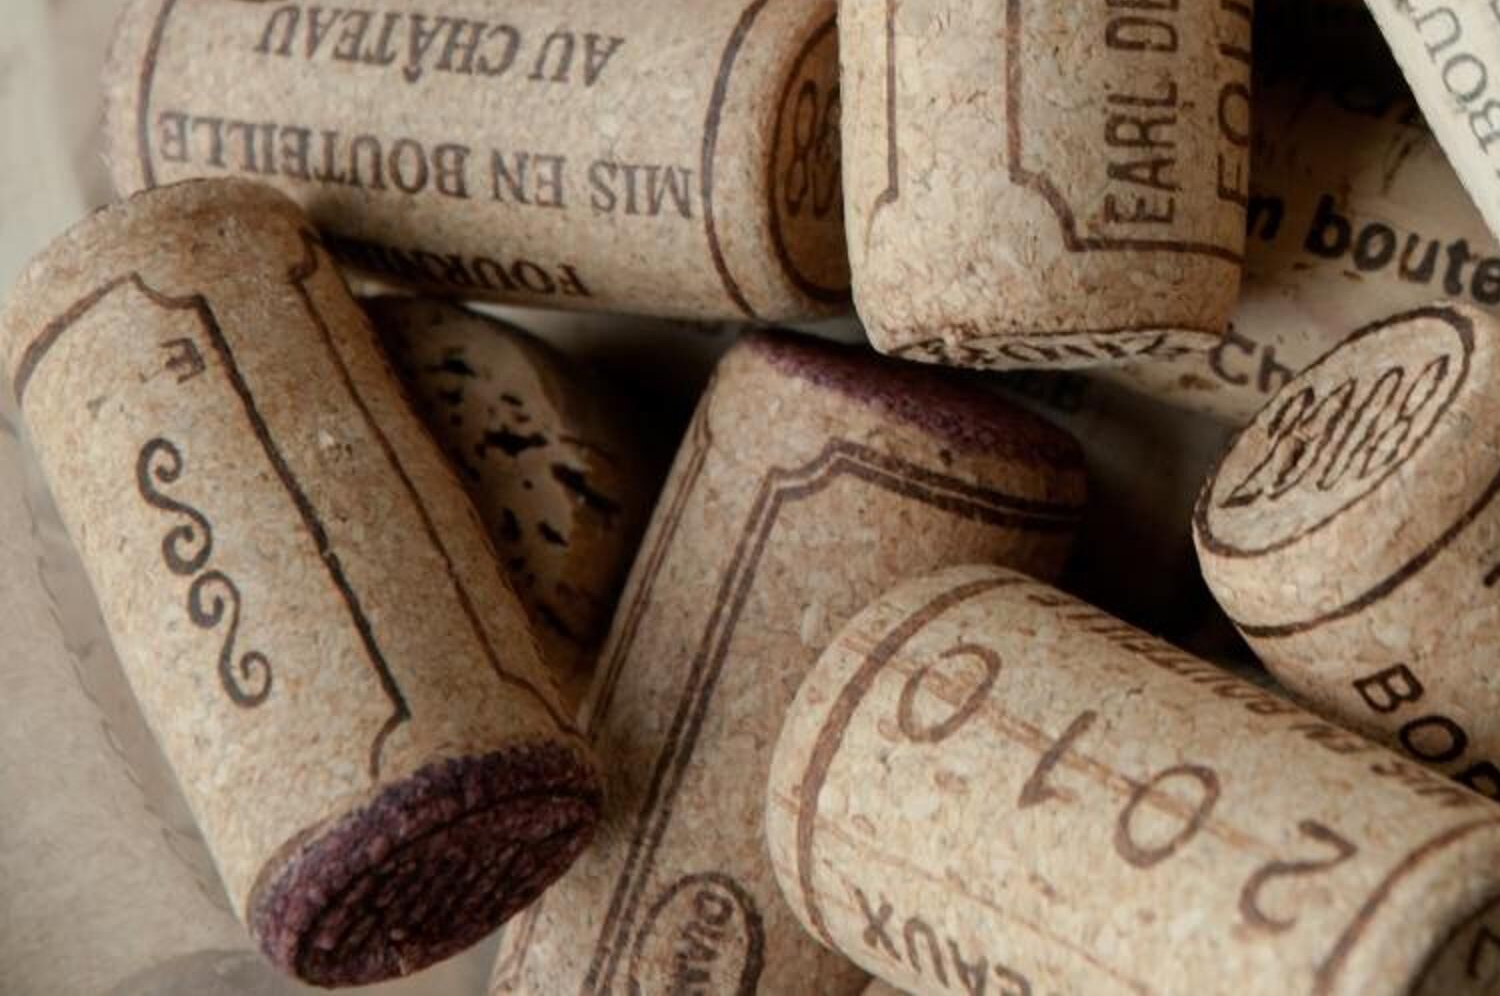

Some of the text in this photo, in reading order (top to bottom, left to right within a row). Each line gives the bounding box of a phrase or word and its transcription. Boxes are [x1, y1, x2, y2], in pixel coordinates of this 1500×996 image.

[254, 3, 626, 88] AU CHÂTEAU
[156, 109, 696, 221] MIS EN BOUTEILLE
[1105, 82, 1180, 228] EARL
[899, 640, 1358, 935] 2010
